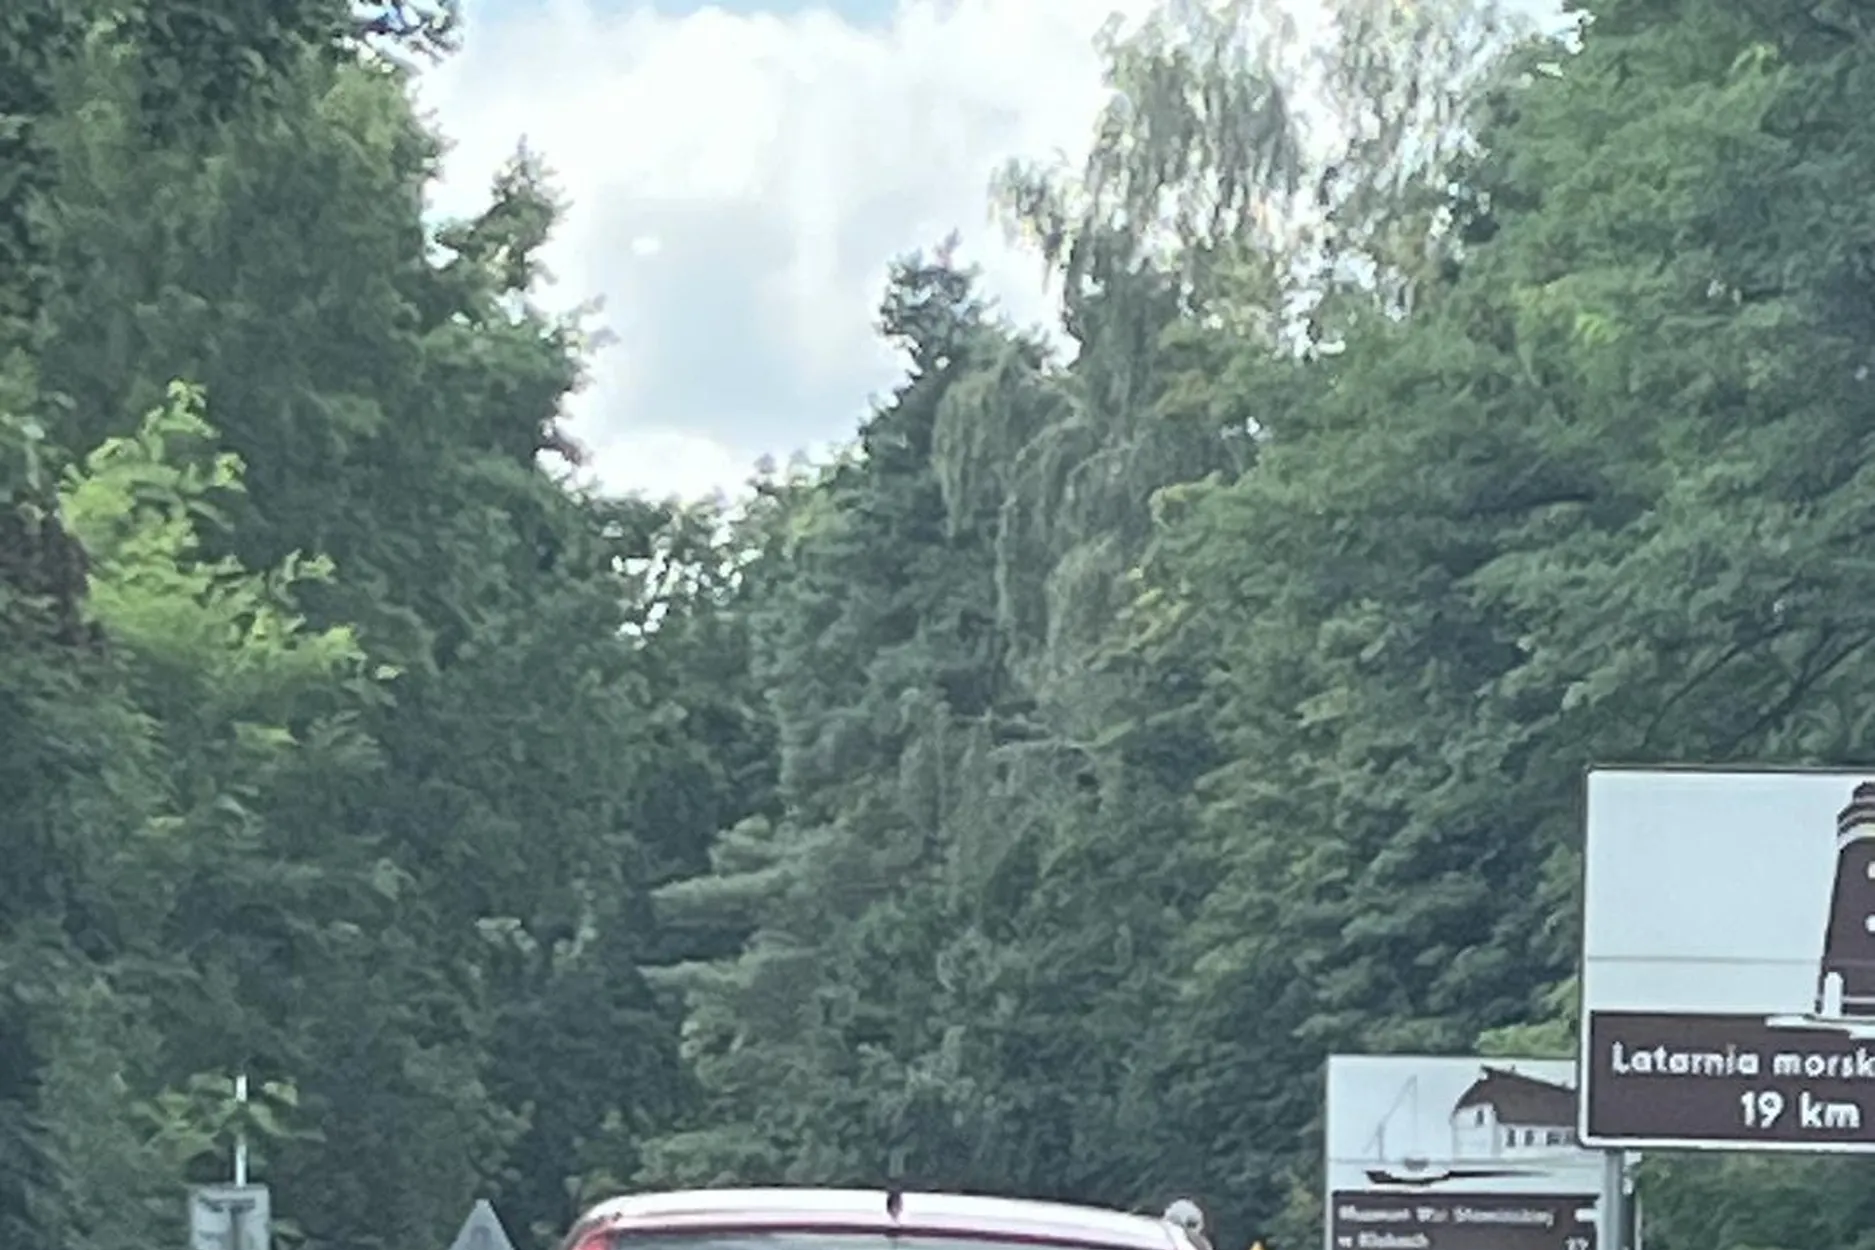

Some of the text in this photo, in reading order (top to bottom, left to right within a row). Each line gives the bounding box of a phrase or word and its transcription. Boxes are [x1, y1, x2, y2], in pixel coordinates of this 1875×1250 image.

[1611, 1041, 1759, 1076] Latarnia
[1741, 1091, 1861, 1129] 19 km
